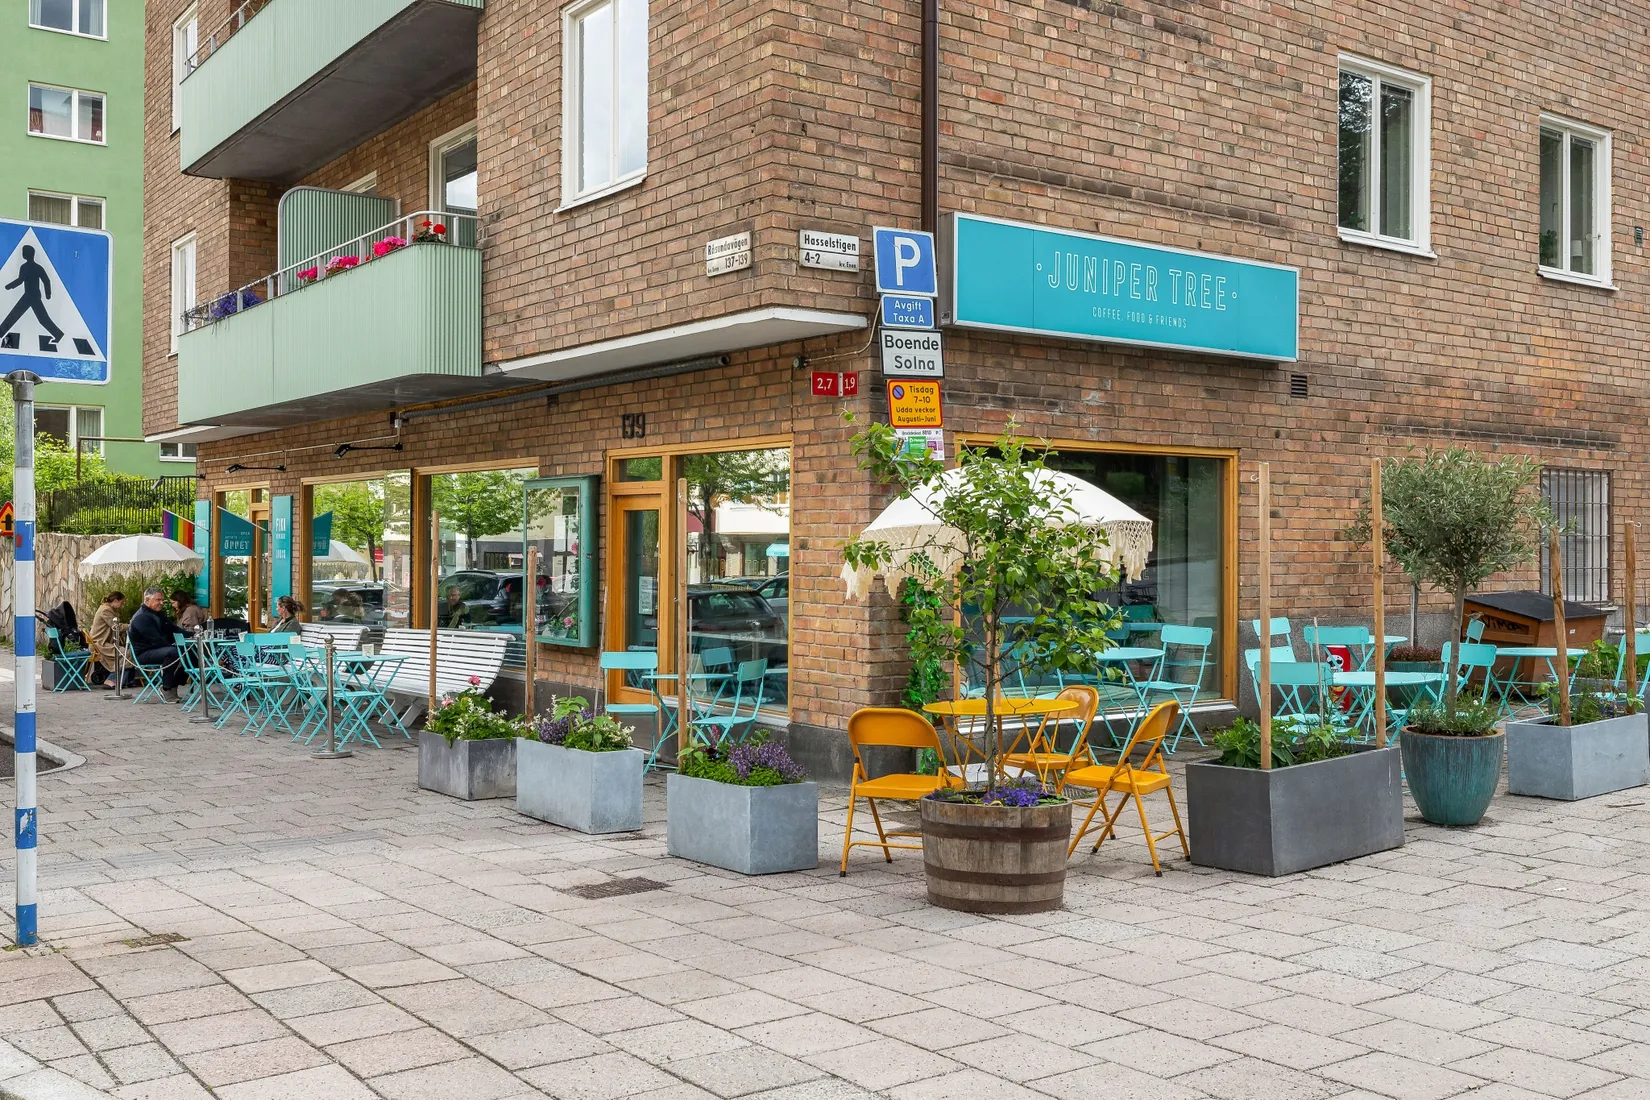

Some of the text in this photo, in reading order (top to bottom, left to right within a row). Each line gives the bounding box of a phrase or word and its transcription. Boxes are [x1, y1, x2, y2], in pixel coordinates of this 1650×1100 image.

[804, 234, 856, 252] Hasselstigen
[725, 253, 748, 268] 137-139
[804, 252, 820, 264] 4-2
[894, 236, 920, 286] P
[1048, 251, 1226, 310] JUNIPER TREE
[894, 300, 922, 312] Avgift
[893, 313, 924, 323] Taxa A
[1127, 311, 1145, 323] FOOD
[1149, 314, 1153, 324] &
[1156, 315, 1187, 328] FRIENDS
[884, 335, 939, 350] Boende
[894, 355, 935, 370] Solna
[817, 377, 833, 390] 2,7
[844, 377, 855, 390] 1,9
[909, 386, 934, 395] Tisdag
[621, 413, 645, 438] 139
[224, 540, 250, 550] ÖPPET
